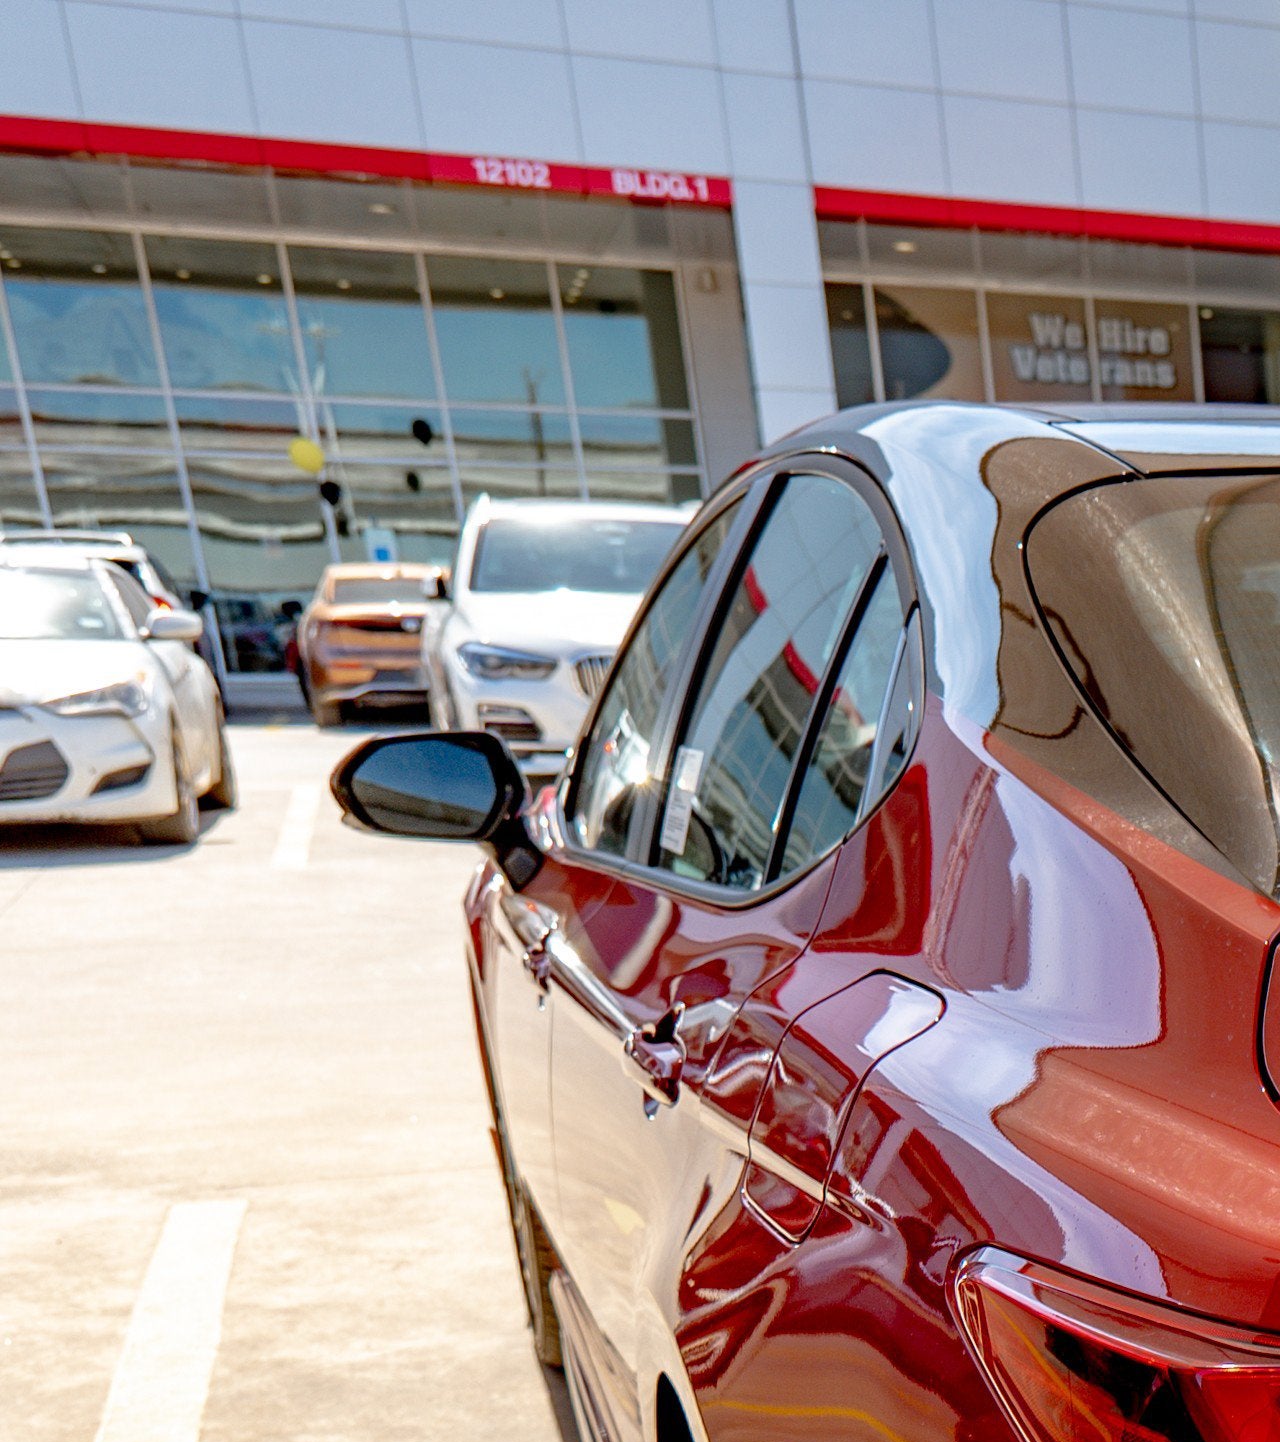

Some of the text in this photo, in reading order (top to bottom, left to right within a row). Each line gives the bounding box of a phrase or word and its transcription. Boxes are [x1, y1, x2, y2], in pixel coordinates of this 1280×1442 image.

[472, 158, 551, 188] 12102
[1029, 311, 1171, 356] We Hire
[1010, 346, 1175, 388] Veterans
